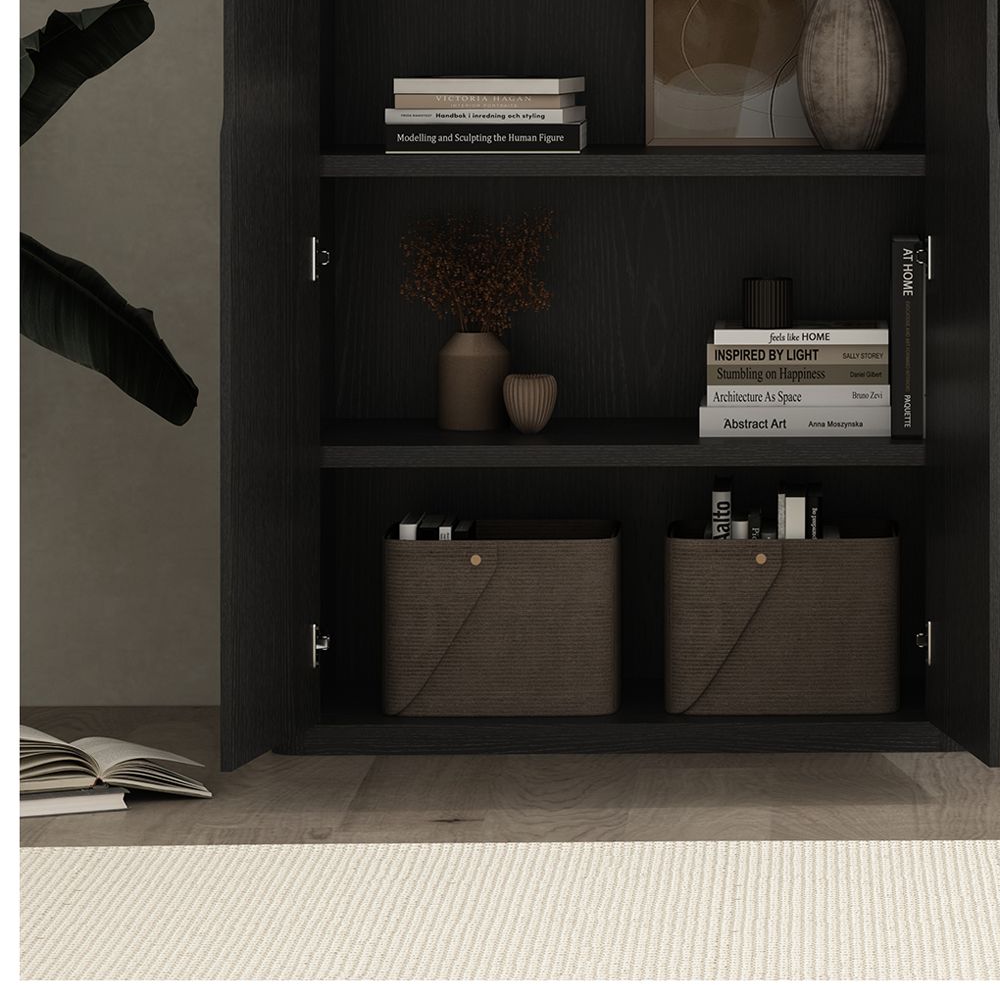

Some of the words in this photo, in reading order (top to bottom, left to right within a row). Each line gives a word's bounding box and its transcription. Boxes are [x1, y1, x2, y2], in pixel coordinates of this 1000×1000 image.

[472, 112, 506, 120] inredning
[522, 112, 545, 120] styling
[397, 134, 436, 144] Modelling
[438, 134, 453, 142] and
[454, 134, 492, 144] Sculpting
[494, 134, 506, 142] the
[508, 134, 538, 142] Human
[539, 134, 564, 144] Figure
[902, 248, 914, 261] AT
[902, 263, 914, 296] HOME
[768, 332, 786, 344] feels
[786, 332, 800, 341] like
[802, 332, 830, 341] HOME
[714, 349, 766, 361] INSPIRED
[768, 349, 784, 361] BY
[786, 349, 820, 361] LIGHT
[842, 352, 860, 360] SALLY
[861, 352, 884, 360] STOREY
[716, 368, 764, 382] Stumbling
[765, 370, 777, 380] on
[779, 368, 826, 382] Happiness
[712, 390, 763, 402] Architecture
[764, 391, 776, 402] As
[778, 391, 802, 405] Space
[852, 391, 870, 400] Bruno
[870, 391, 883, 400] Zevi
[904, 394, 912, 428] PAQUETTE
[724, 418, 768, 429] Abstract
[770, 418, 787, 429] Art
[808, 420, 826, 428] Anna
[827, 420, 864, 429] Moszynska
